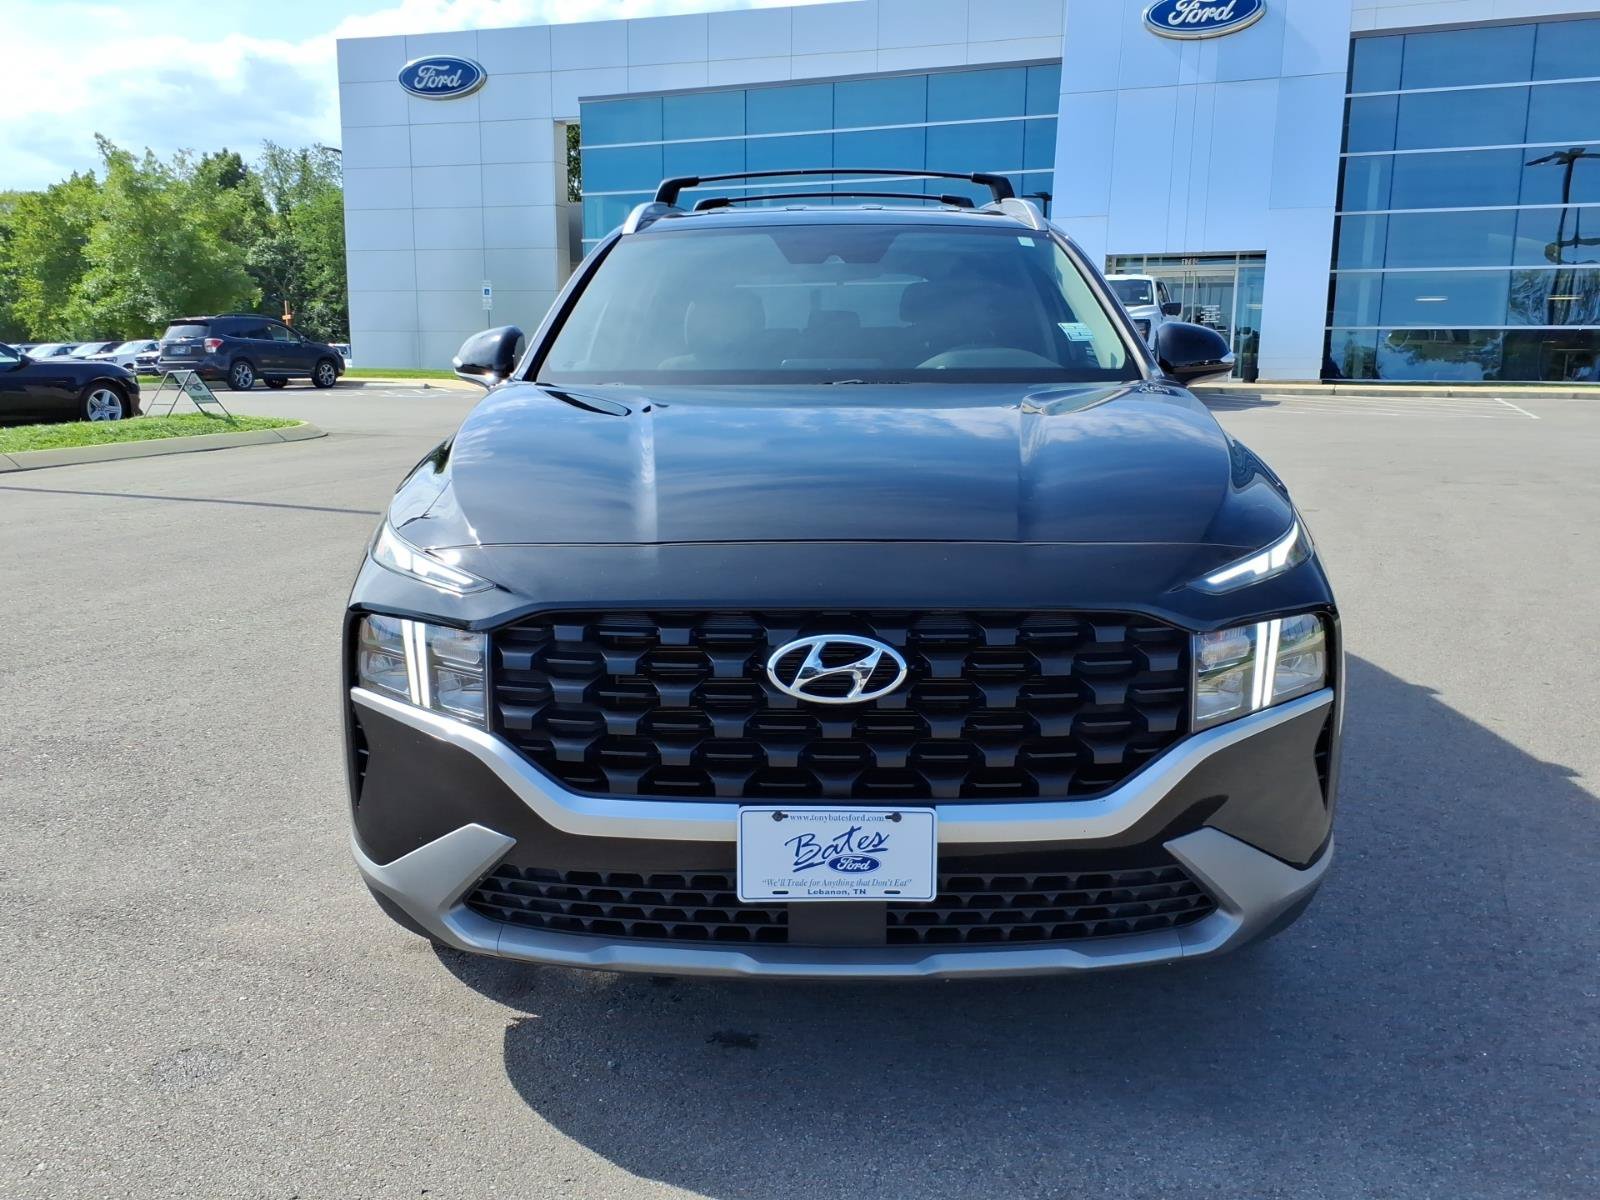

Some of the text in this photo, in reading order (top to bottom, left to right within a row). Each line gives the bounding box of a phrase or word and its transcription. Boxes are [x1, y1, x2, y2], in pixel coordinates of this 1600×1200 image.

[1168, 0, 1237, 25] Ford
[414, 65, 462, 89] Ford
[790, 813, 885, 823] www.tonybatesford.com
[784, 825, 890, 867] Bates
[836, 855, 871, 871] Ford
[786, 878, 808, 887] Trade
[808, 878, 821, 888] for
[821, 878, 855, 888] Anything
[855, 878, 871, 887] that
[871, 878, 894, 887] Don't
[807, 888, 850, 896] Lebanon,
